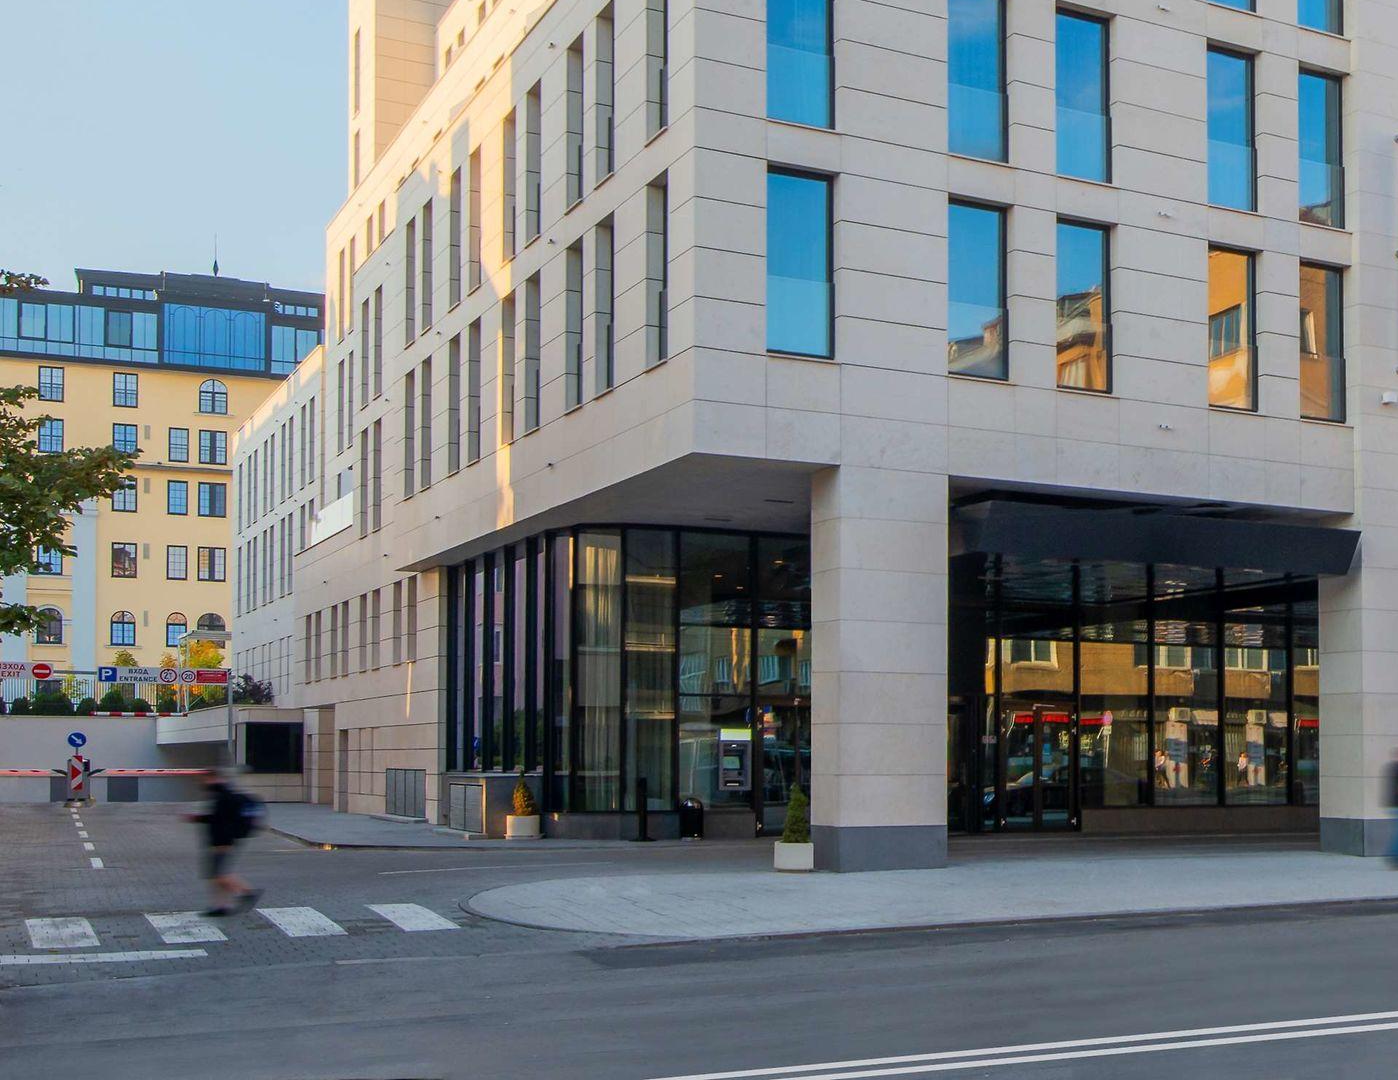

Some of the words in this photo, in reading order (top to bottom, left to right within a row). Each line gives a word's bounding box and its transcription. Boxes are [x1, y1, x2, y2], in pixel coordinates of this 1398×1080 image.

[1, 670, 21, 678] EXIT
[101, 669, 113, 681] P
[184, 673, 193, 681] 20
[119, 675, 158, 683] ENTRANCE
